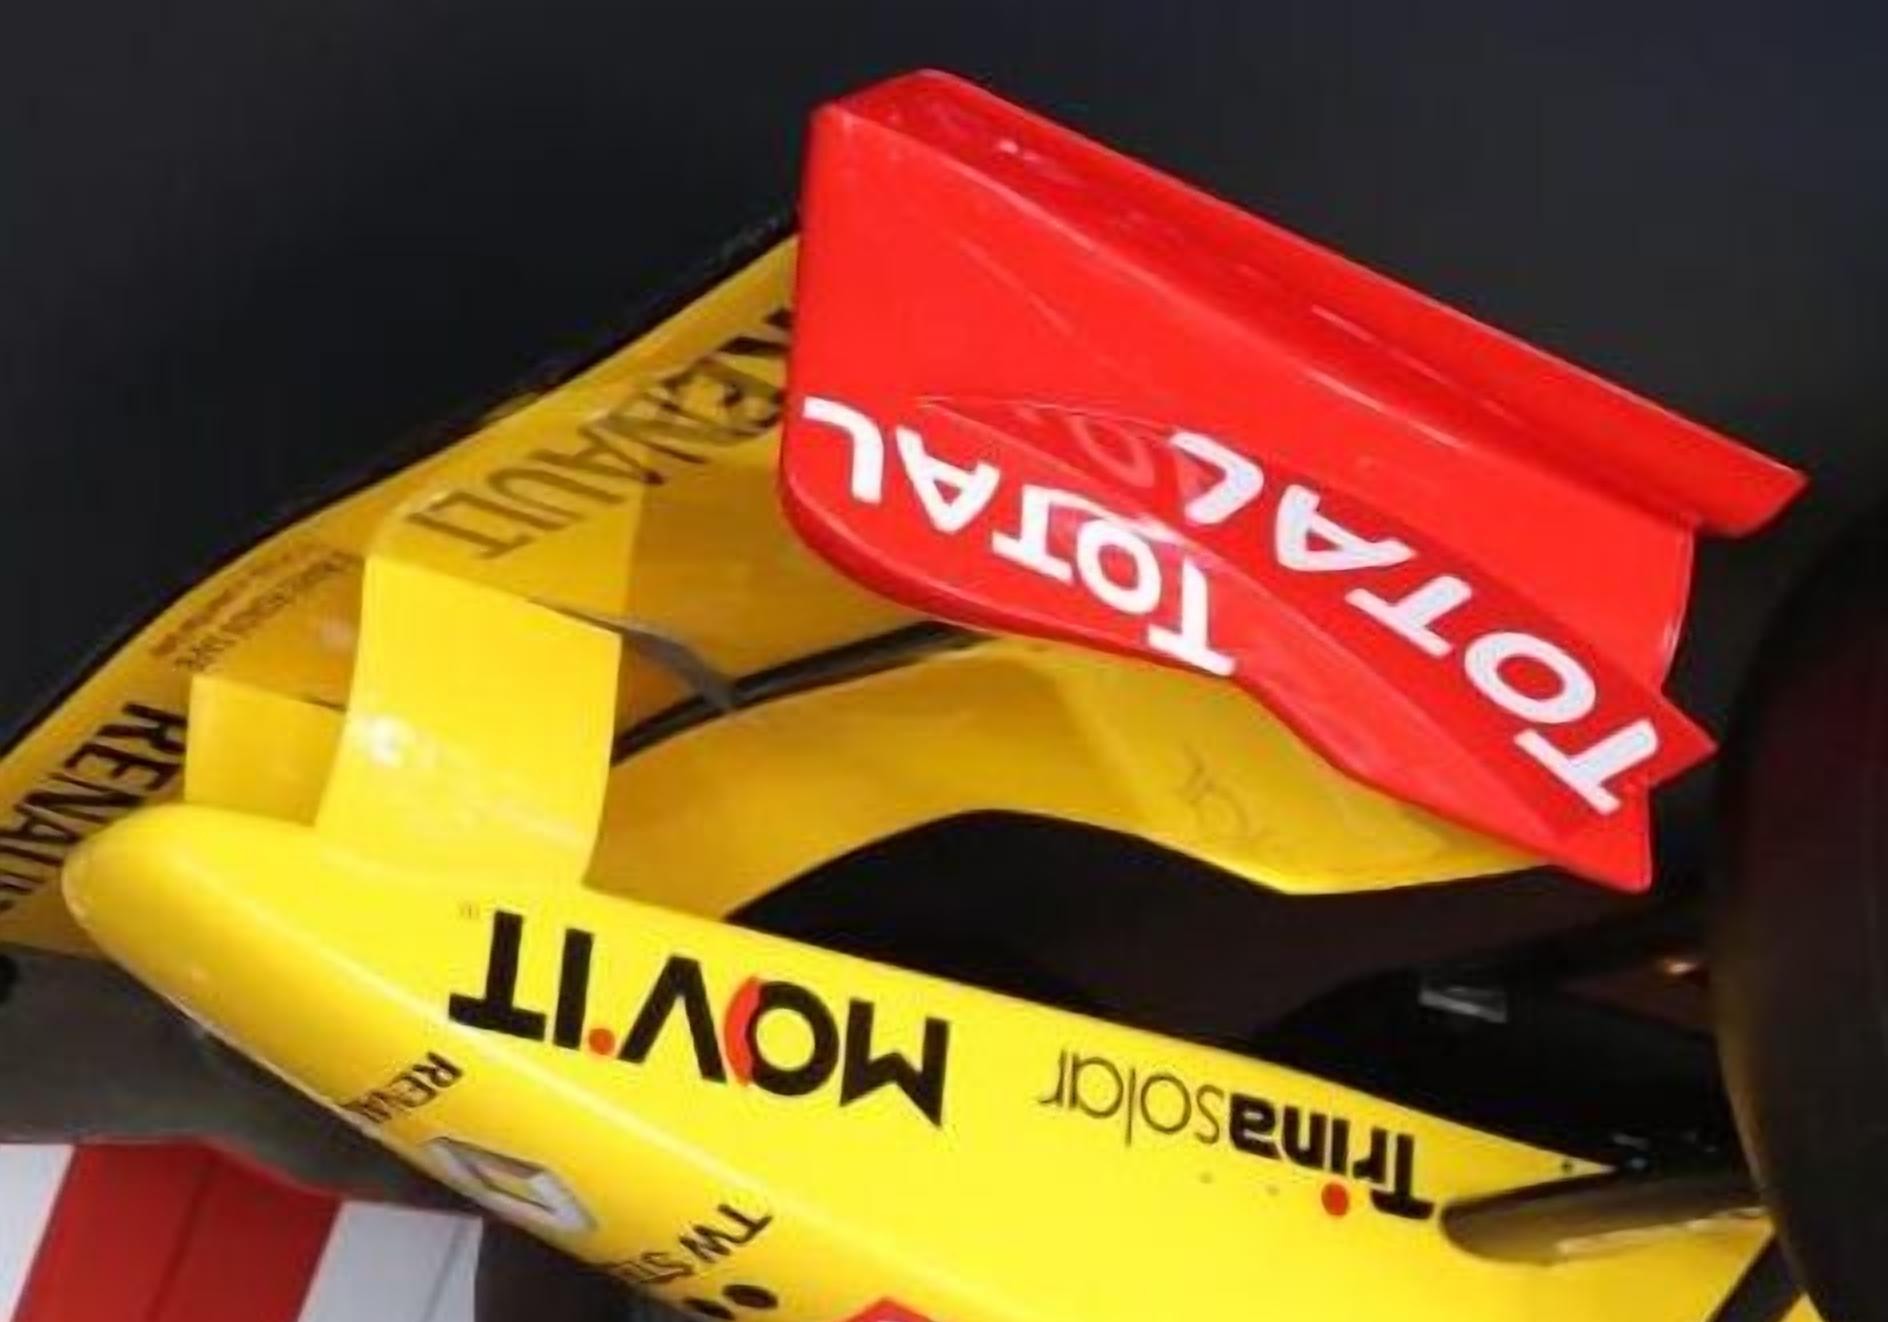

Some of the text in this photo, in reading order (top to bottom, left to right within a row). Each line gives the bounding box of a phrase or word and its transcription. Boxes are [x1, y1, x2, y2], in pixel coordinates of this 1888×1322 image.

[802, 398, 1236, 676] TOTAL
[1168, 432, 1659, 815] TOTAL
[0, 702, 189, 910] RENAU
[678, 1203, 774, 1264] TW
[1037, 1048, 1435, 1222] Trinasolar
